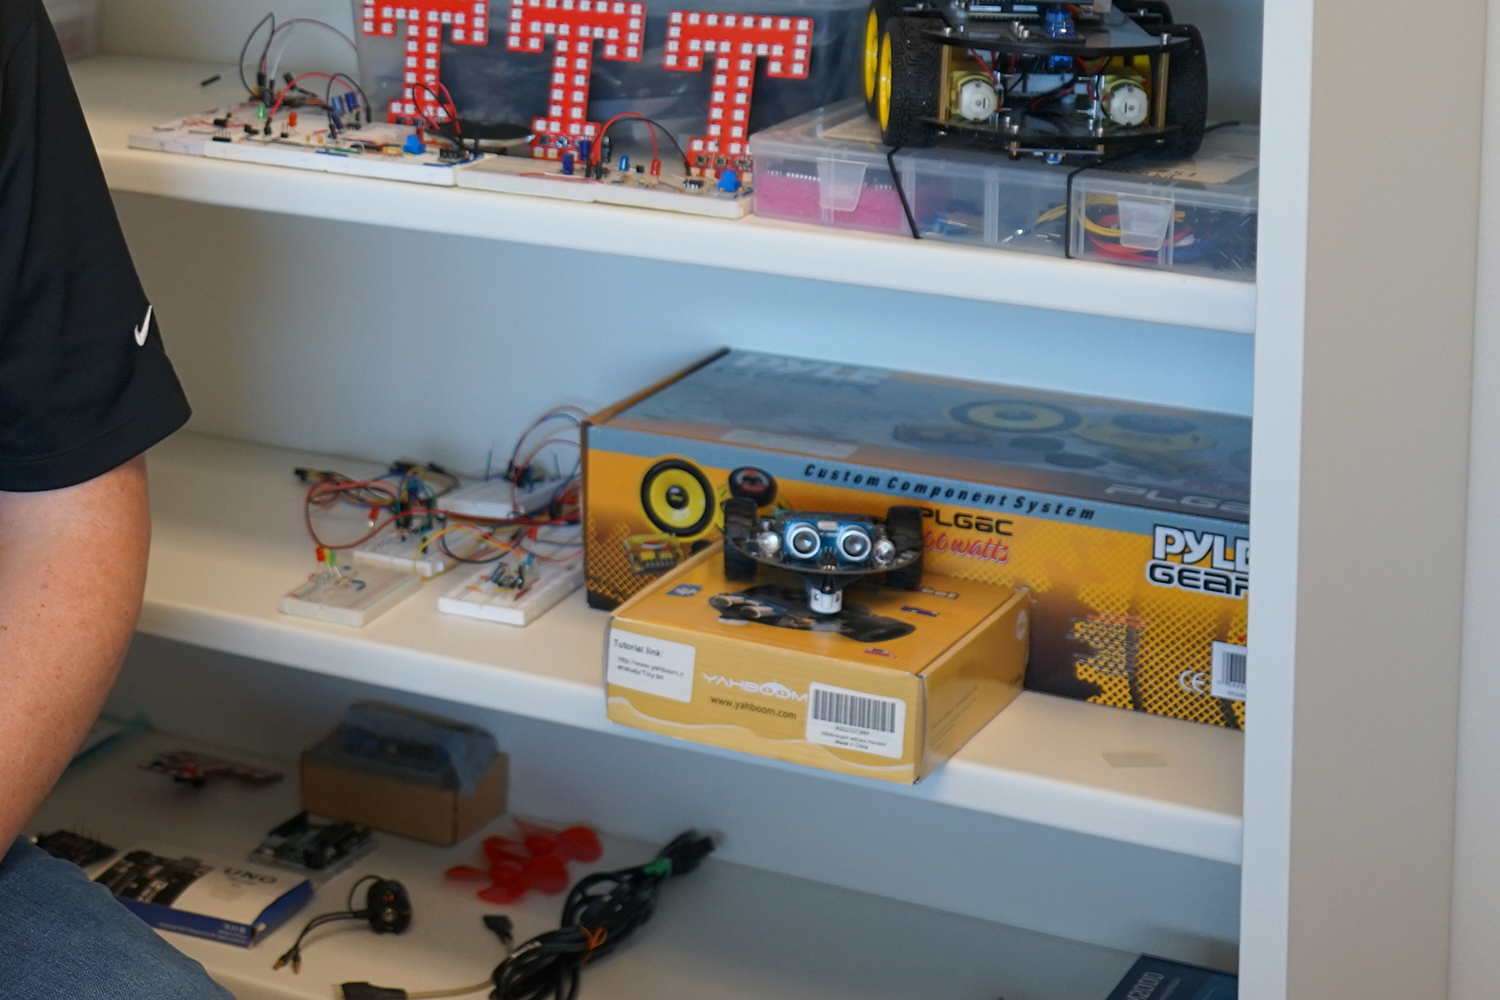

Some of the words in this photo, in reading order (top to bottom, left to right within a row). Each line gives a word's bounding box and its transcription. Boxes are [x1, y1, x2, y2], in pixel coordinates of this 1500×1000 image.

[804, 463, 881, 488] Custom
[887, 476, 1008, 506] Component
[1013, 496, 1097, 521] System
[614, 638, 645, 654] Tutorial
[702, 672, 808, 703] YAHBOOM
[710, 695, 797, 720] www.yahboom.com
